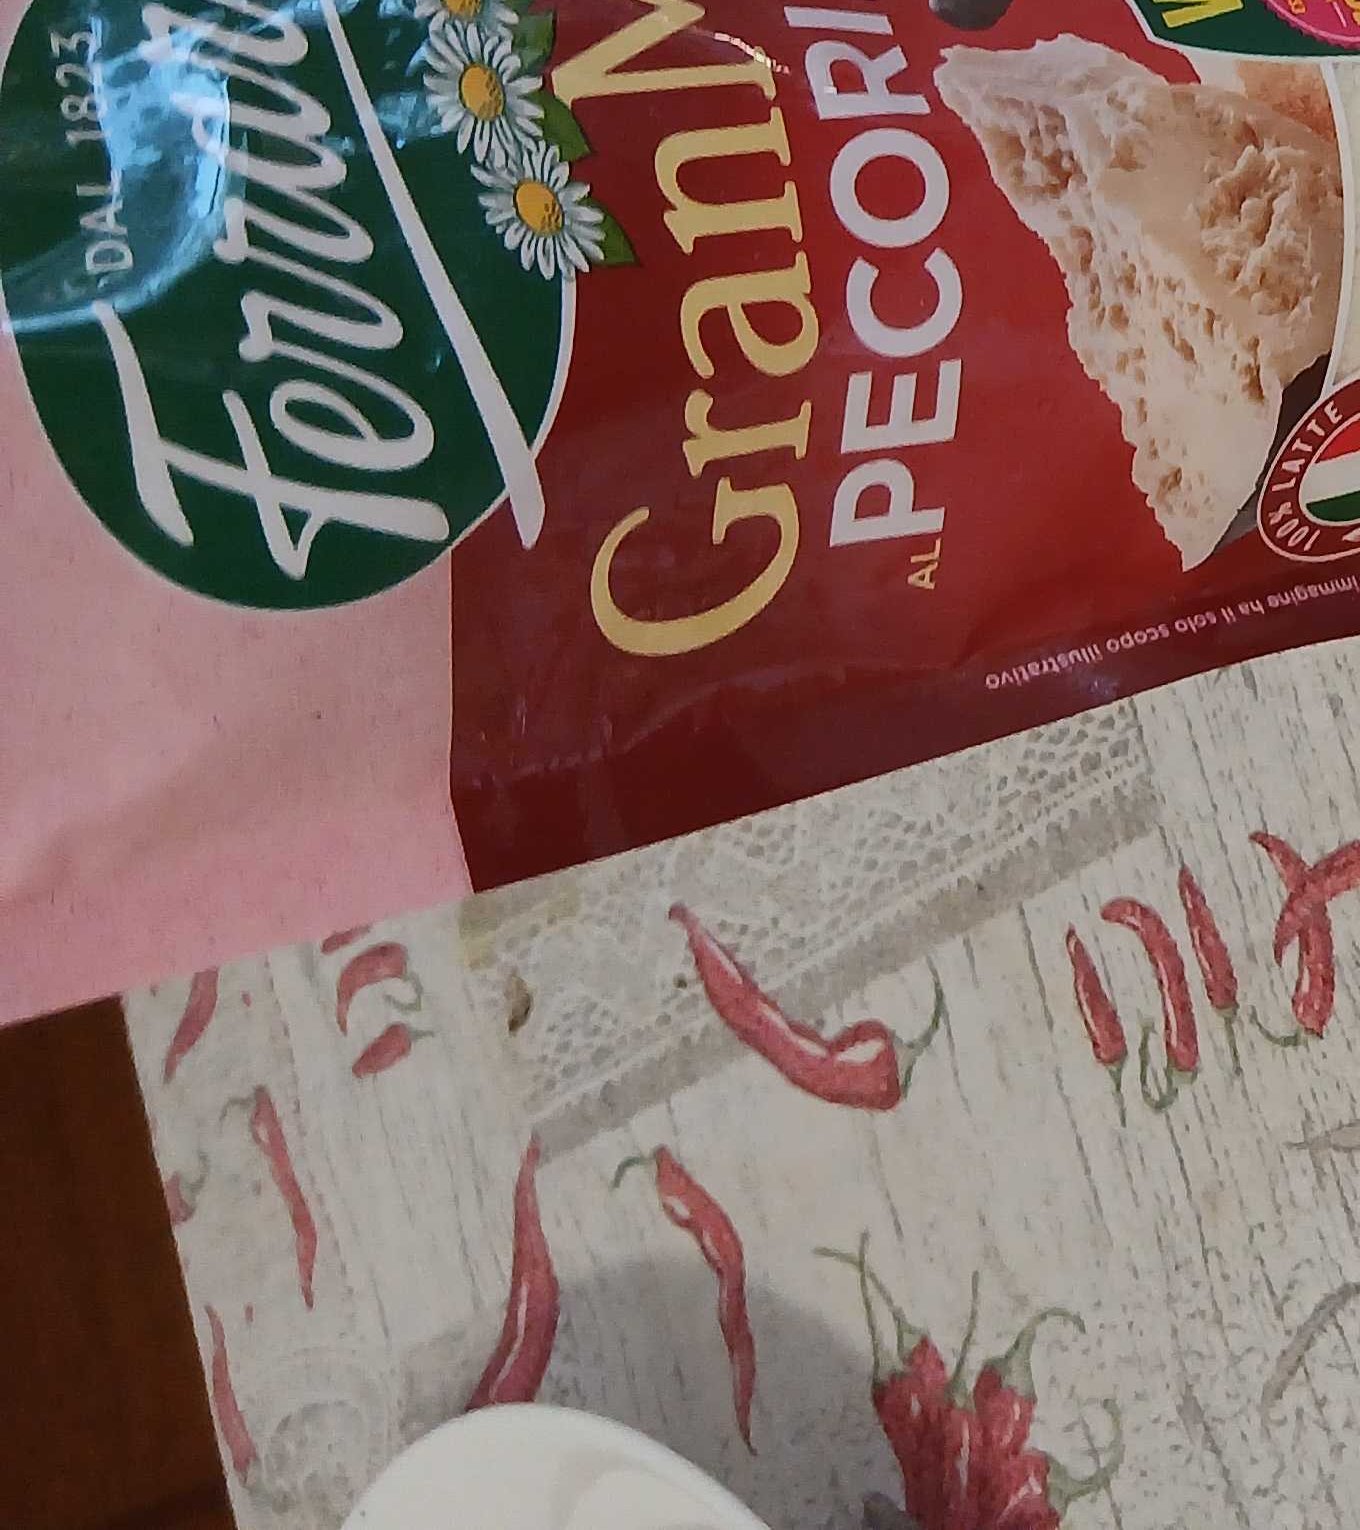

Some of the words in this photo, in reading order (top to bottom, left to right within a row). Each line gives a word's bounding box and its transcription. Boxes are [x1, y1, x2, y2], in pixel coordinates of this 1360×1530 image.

[50, 29, 107, 146] 1823
[80, 182, 136, 276] DAL
[1270, 400, 1343, 492] LATTE
[1267, 501, 1321, 552] 100%
[906, 536, 944, 591] AL
[1174, 610, 1217, 634] solo
[1220, 607, 1236, 623] il
[1238, 598, 1264, 617] ha
[1105, 621, 1170, 655] scopo
[984, 644, 1104, 691] illustrativo
